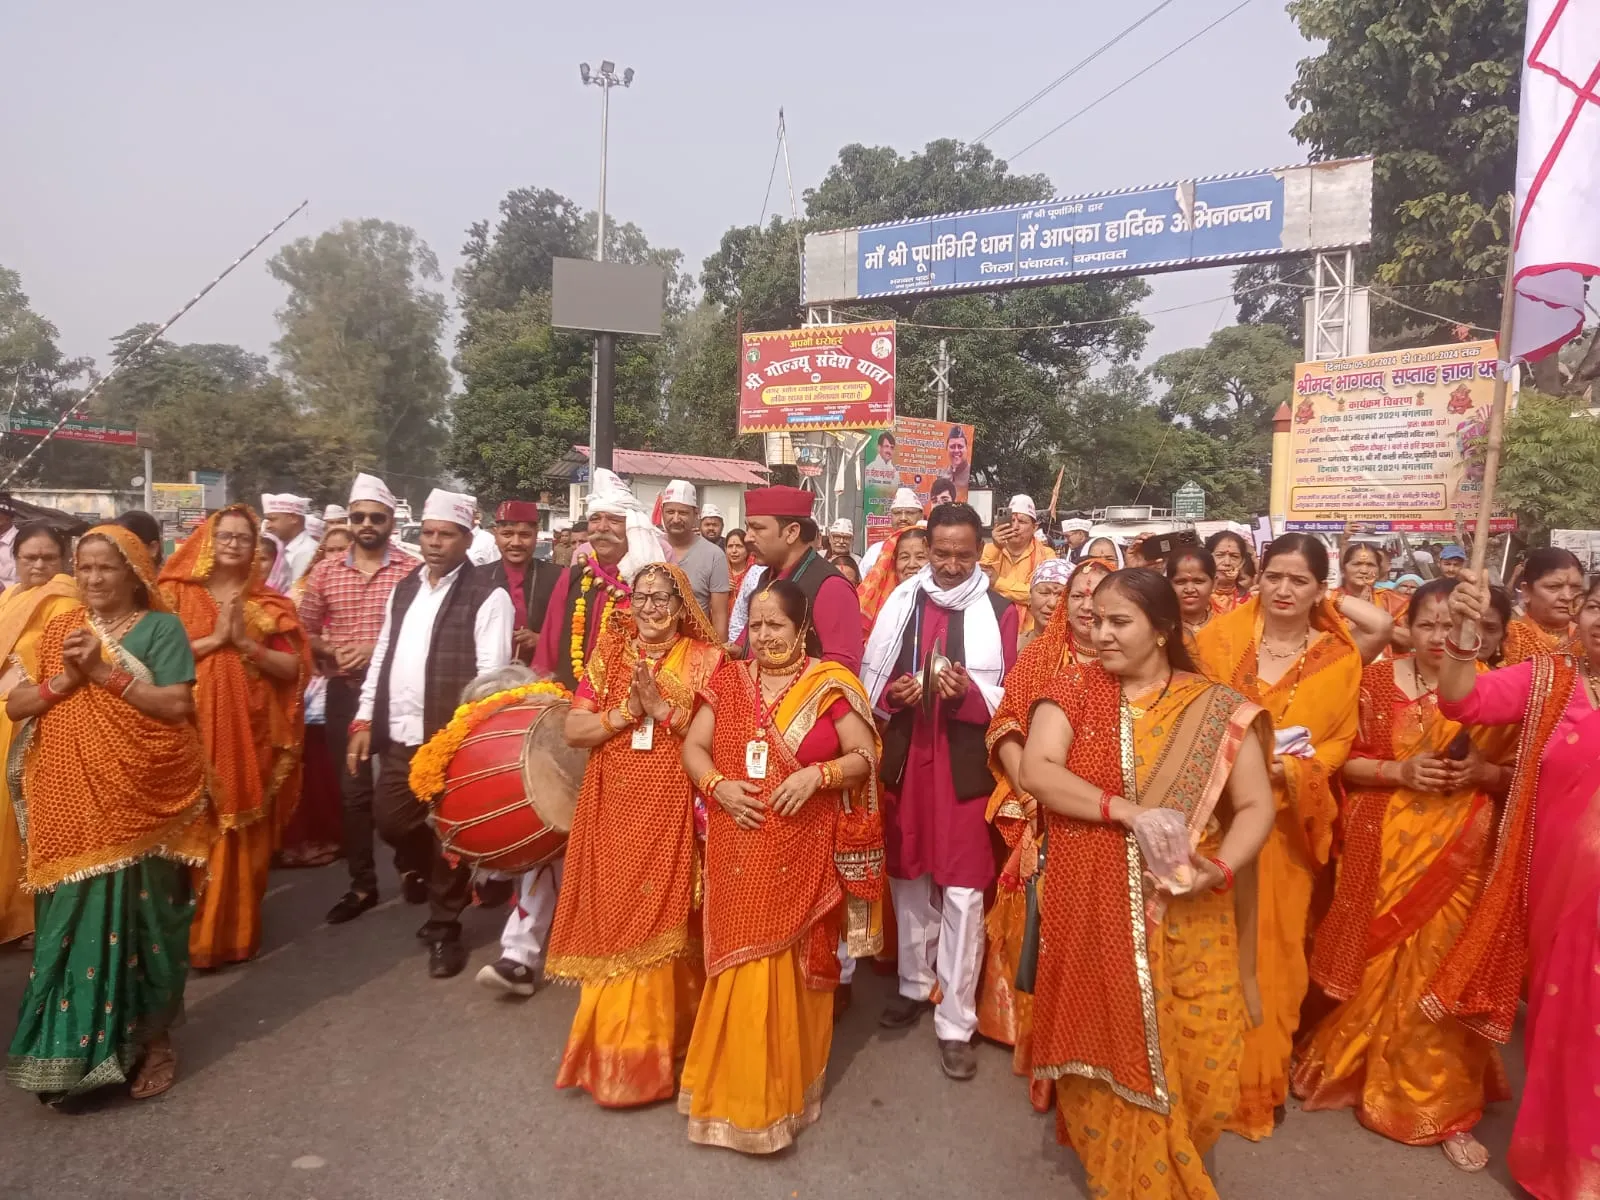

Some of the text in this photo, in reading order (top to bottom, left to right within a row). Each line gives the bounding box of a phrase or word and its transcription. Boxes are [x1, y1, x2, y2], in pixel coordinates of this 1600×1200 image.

[864, 244, 886, 270] माँ
[888, 241, 908, 268] श्री
[912, 231, 978, 272] पूर्णागिरि
[980, 234, 1014, 256] धाम
[1020, 224, 1039, 250] में
[1040, 223, 1100, 248] आपका
[1105, 208, 1166, 243] हार्दिक
[980, 261, 1013, 274] जिला
[1074, 248, 1128, 264] चम्पावत
[745, 372, 765, 390] श्री
[816, 352, 854, 369] संदेश
[856, 358, 893, 385] यात्रा
[1324, 360, 1352, 372] दिनांक
[1402, 352, 1410, 364] से
[1460, 346, 1482, 358] तक
[1391, 364, 1438, 386] सप्ताह
[1441, 362, 1474, 384] ज्ञान
[1343, 414, 1353, 422] 05
[1378, 411, 1400, 419] 2024
[1378, 464, 1400, 472] 2024
